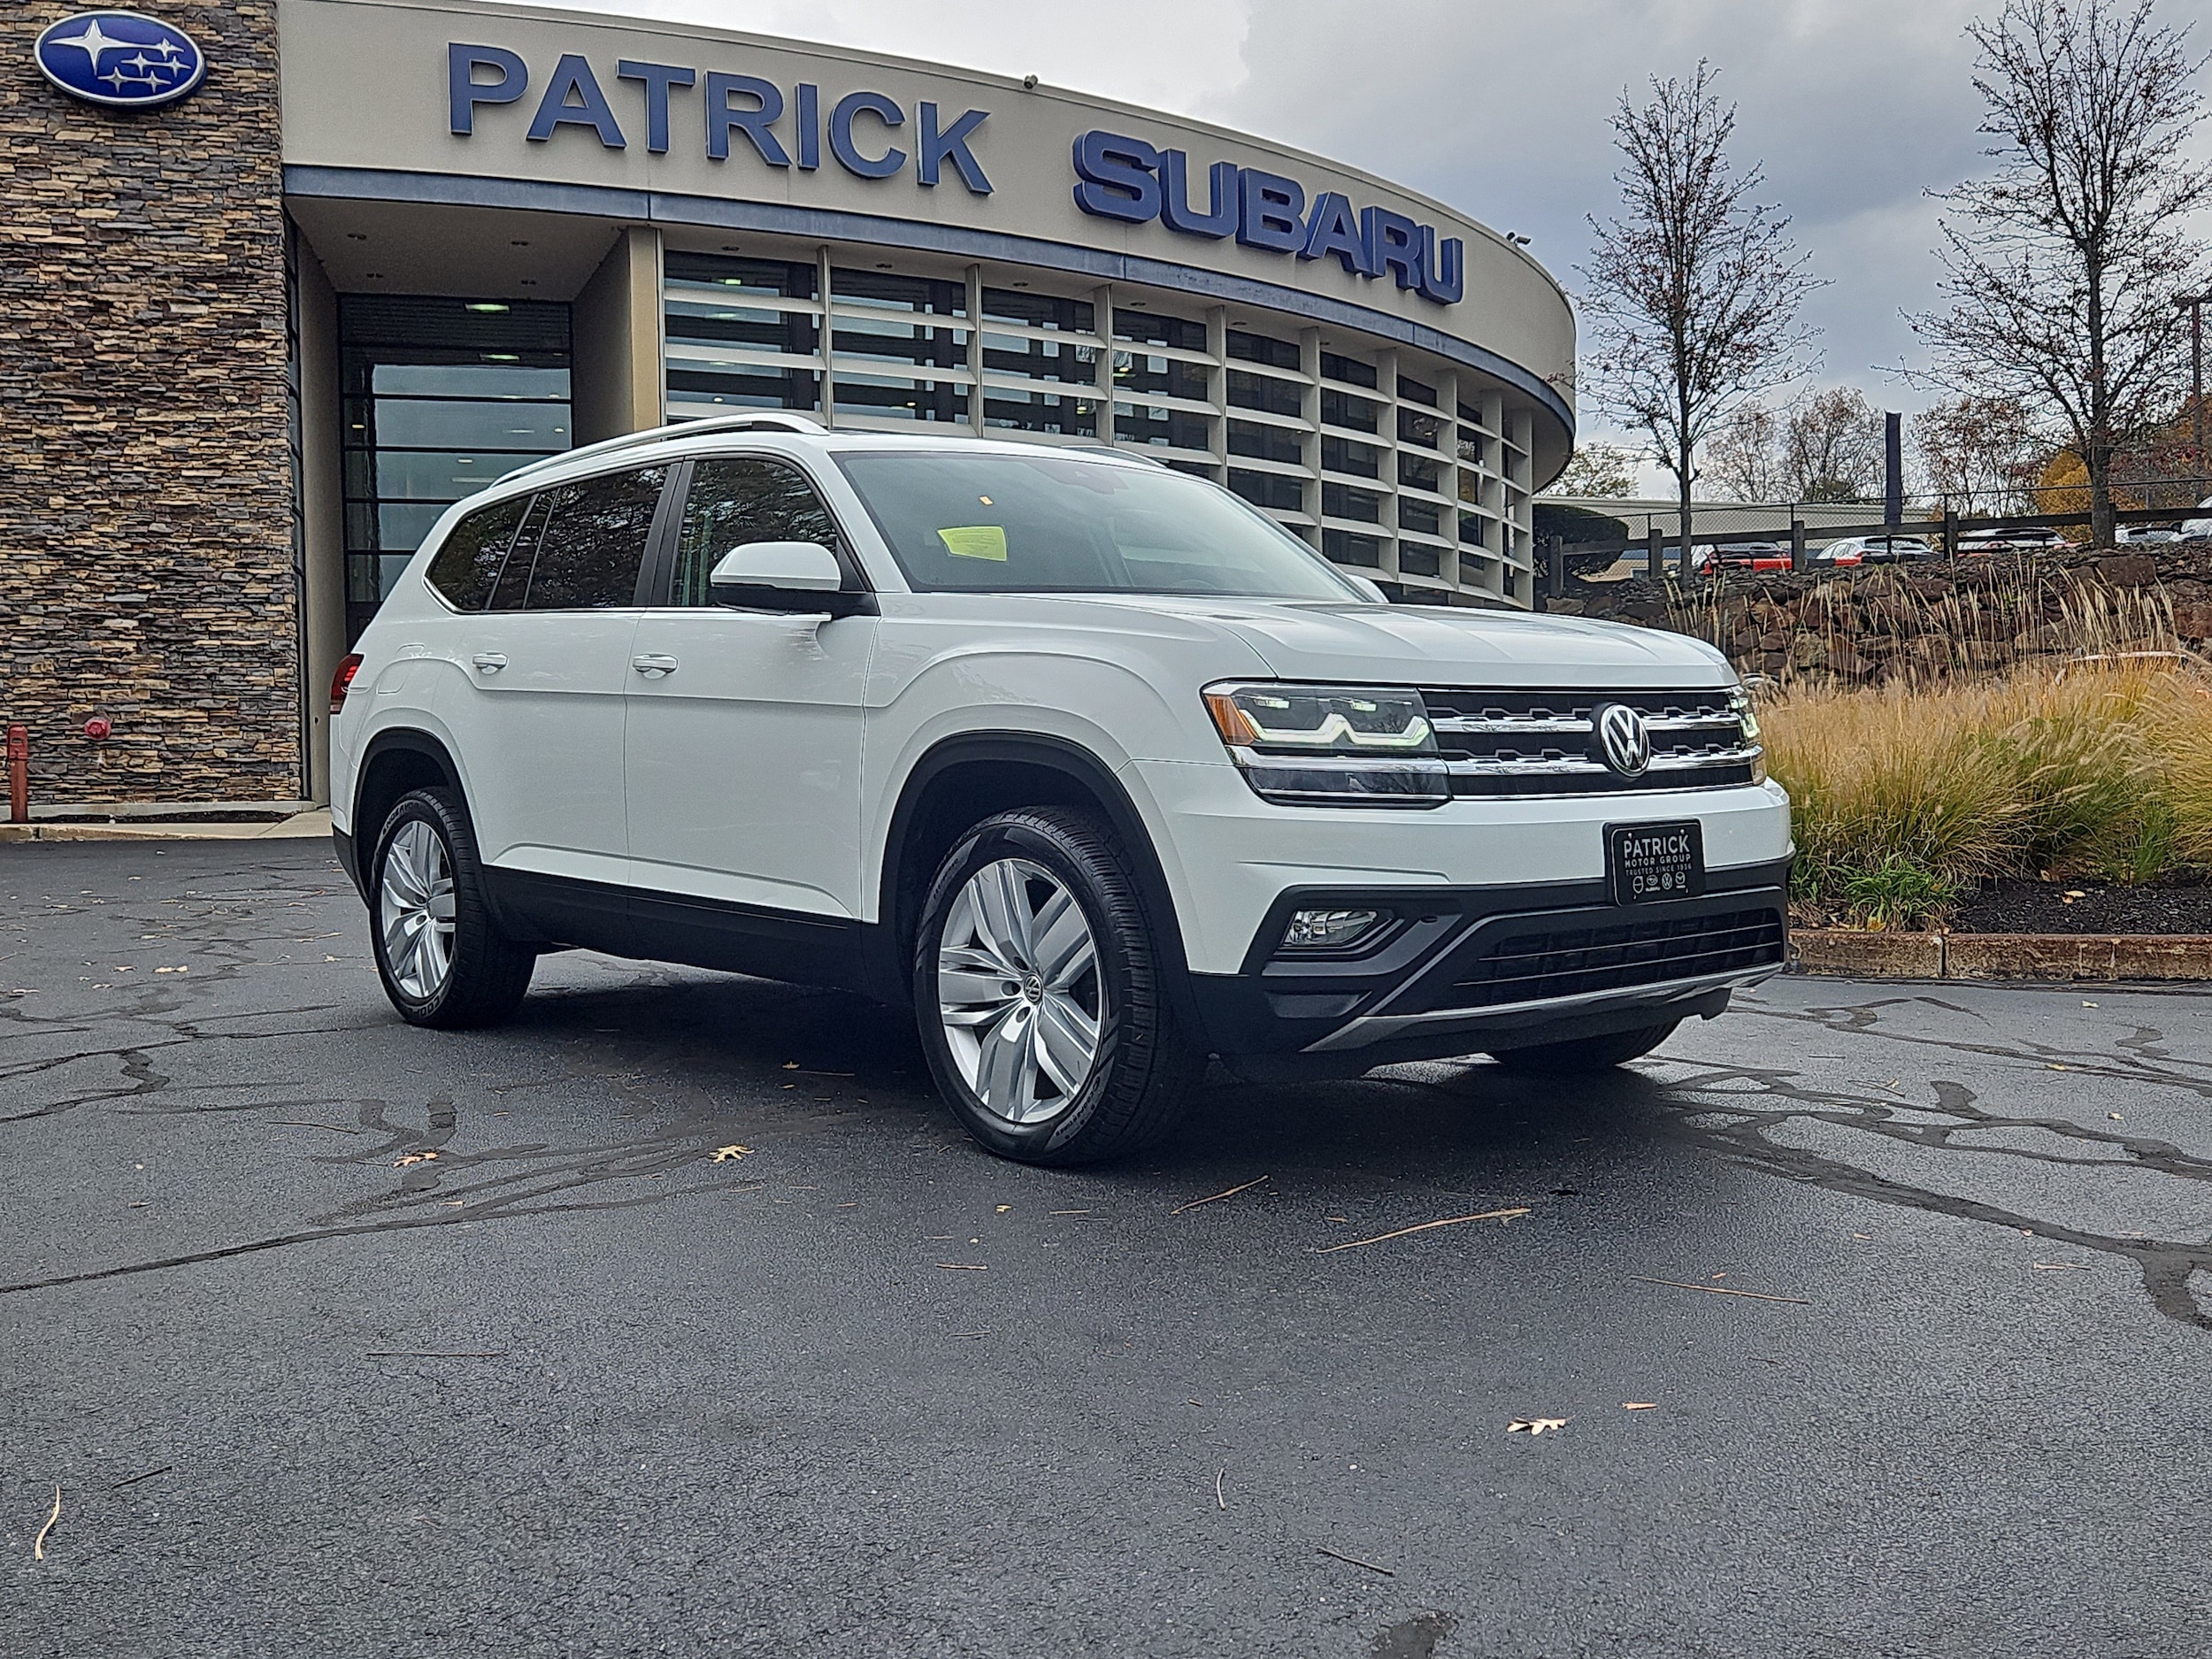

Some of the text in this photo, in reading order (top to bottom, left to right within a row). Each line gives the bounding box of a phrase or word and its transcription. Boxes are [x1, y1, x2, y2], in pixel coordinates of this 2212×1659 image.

[447, 41, 1463, 305] PATRICK SUBARU
[1623, 834, 1690, 858] PATRICK
[1624, 854, 1691, 868] MOTOR GROUP
[1625, 866, 1654, 877] TRUSTED
[1655, 864, 1675, 873] SINCE
